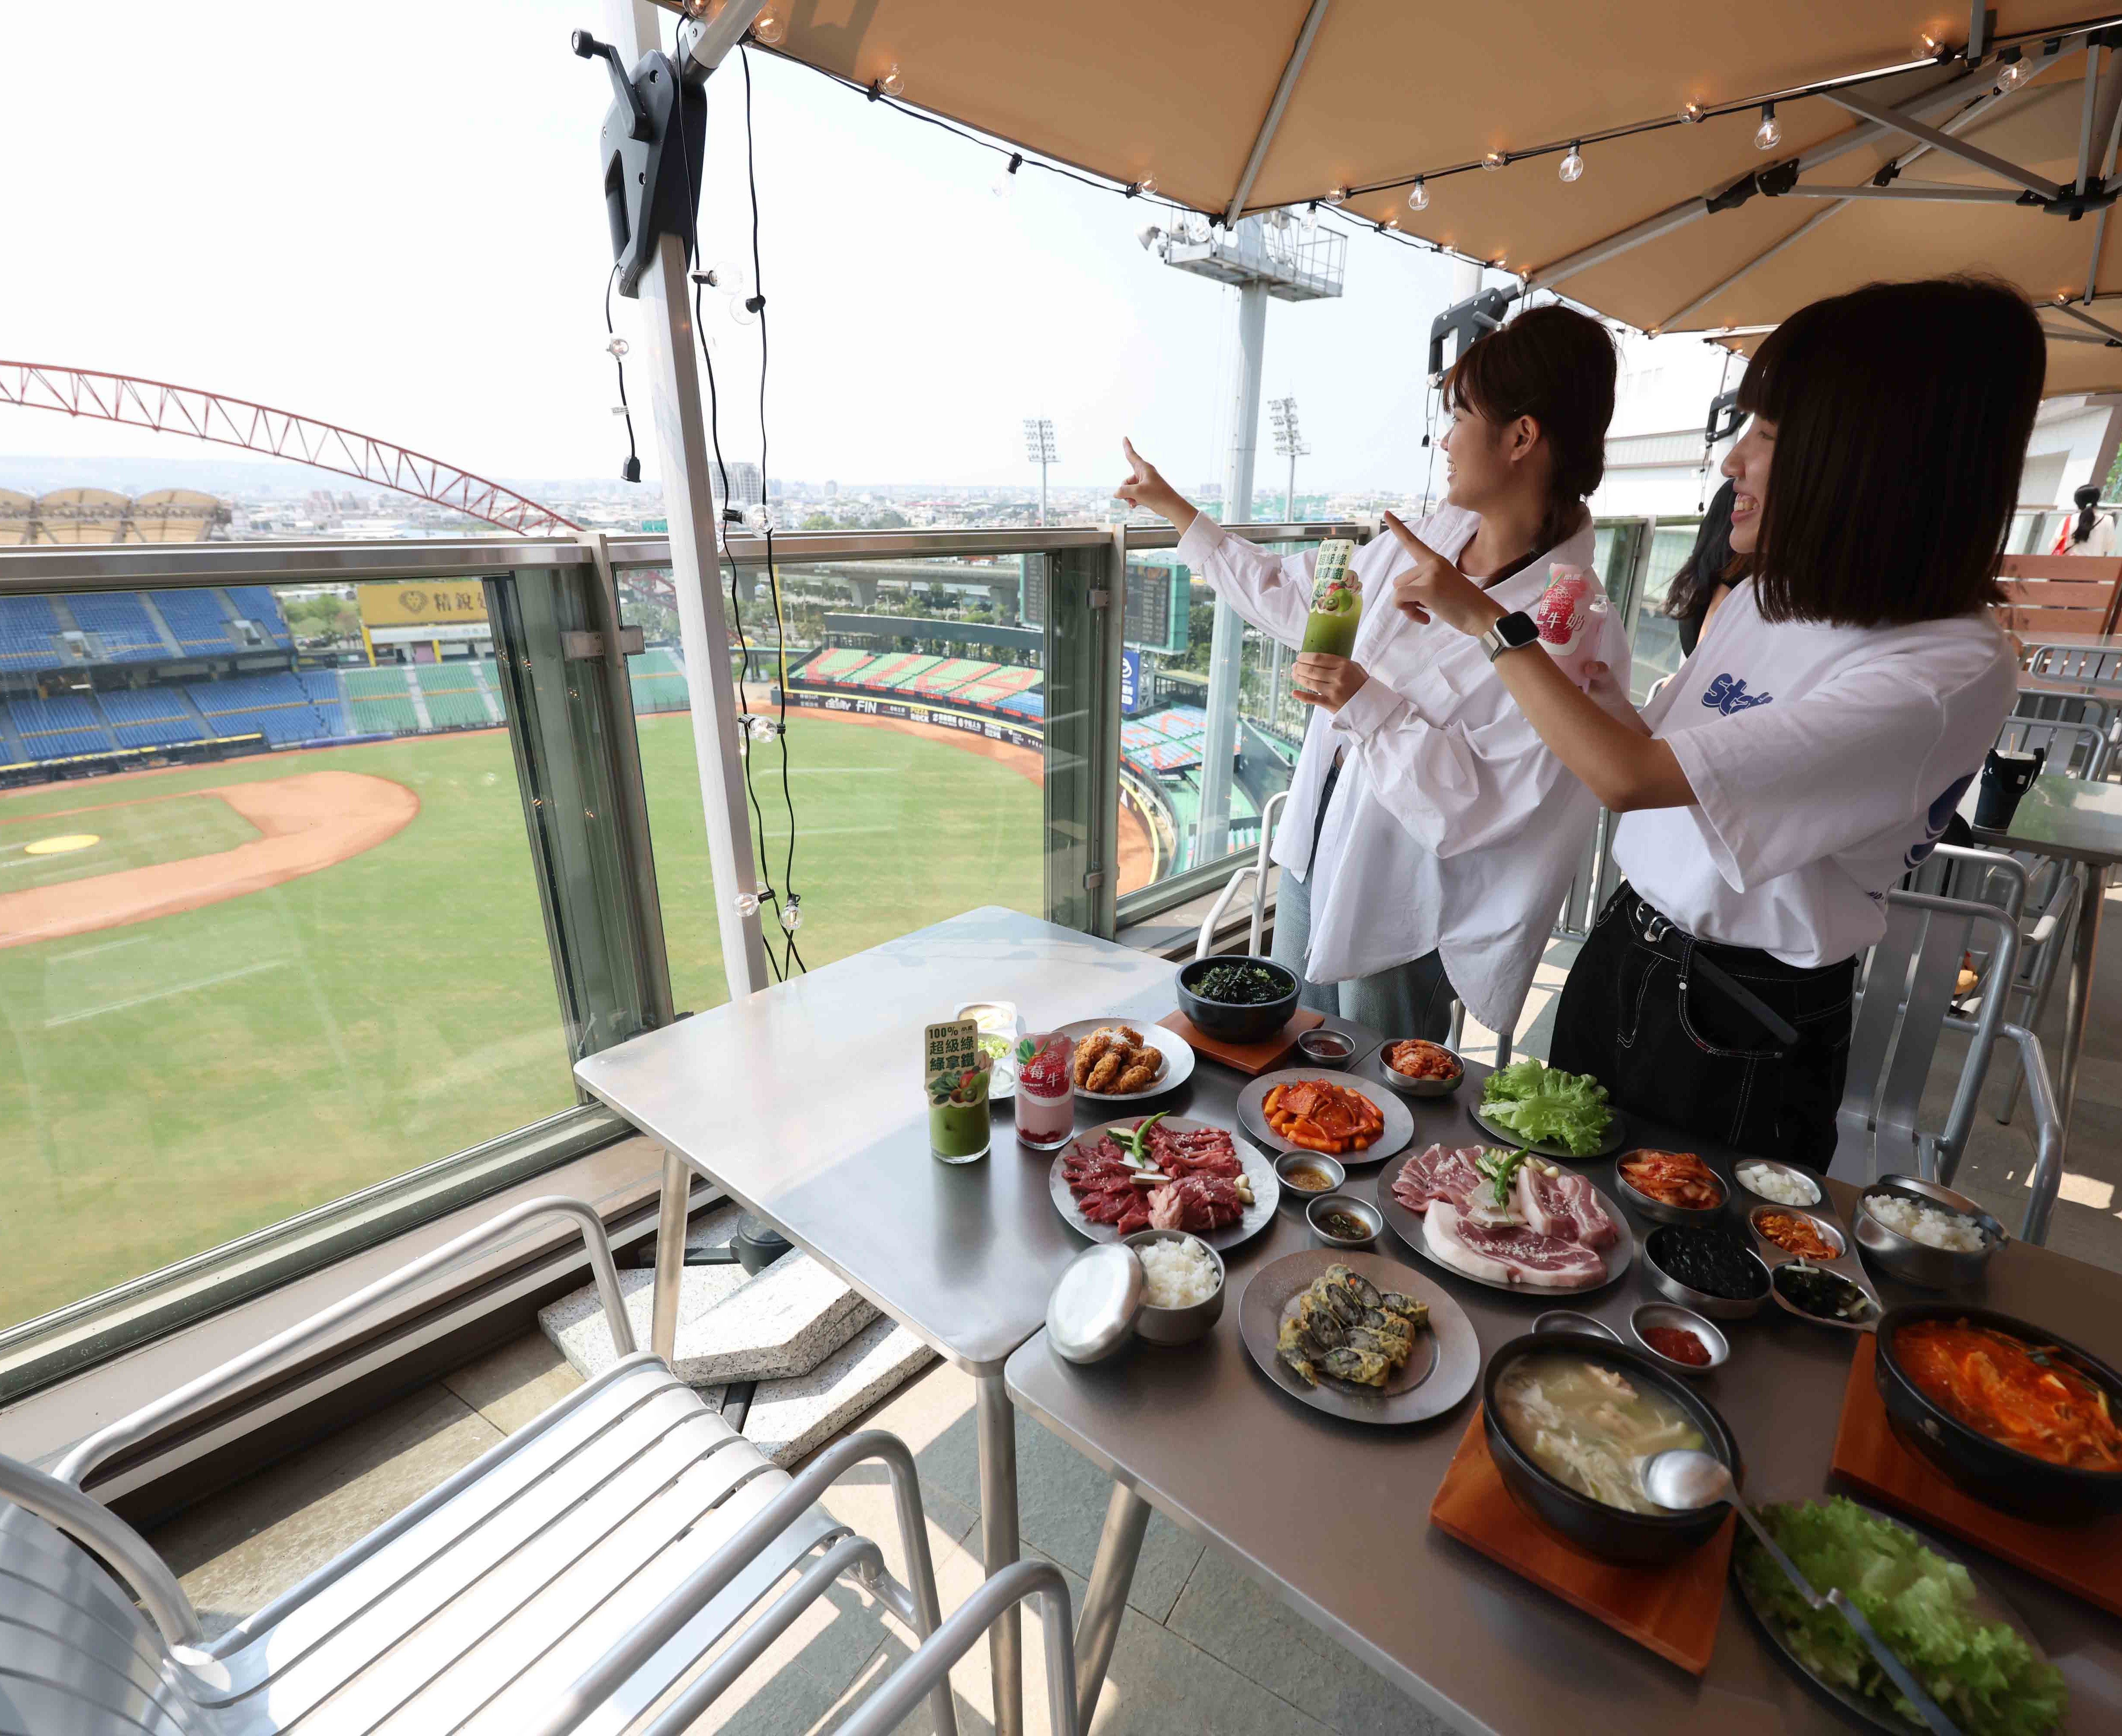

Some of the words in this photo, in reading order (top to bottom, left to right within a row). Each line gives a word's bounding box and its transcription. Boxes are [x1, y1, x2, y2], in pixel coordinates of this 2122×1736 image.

[1321, 543, 1338, 552] 100%
[929, 1026, 958, 1039] 100%
[929, 1036, 974, 1055] 超級綠
[929, 1052, 975, 1072] 綠拿鐵
